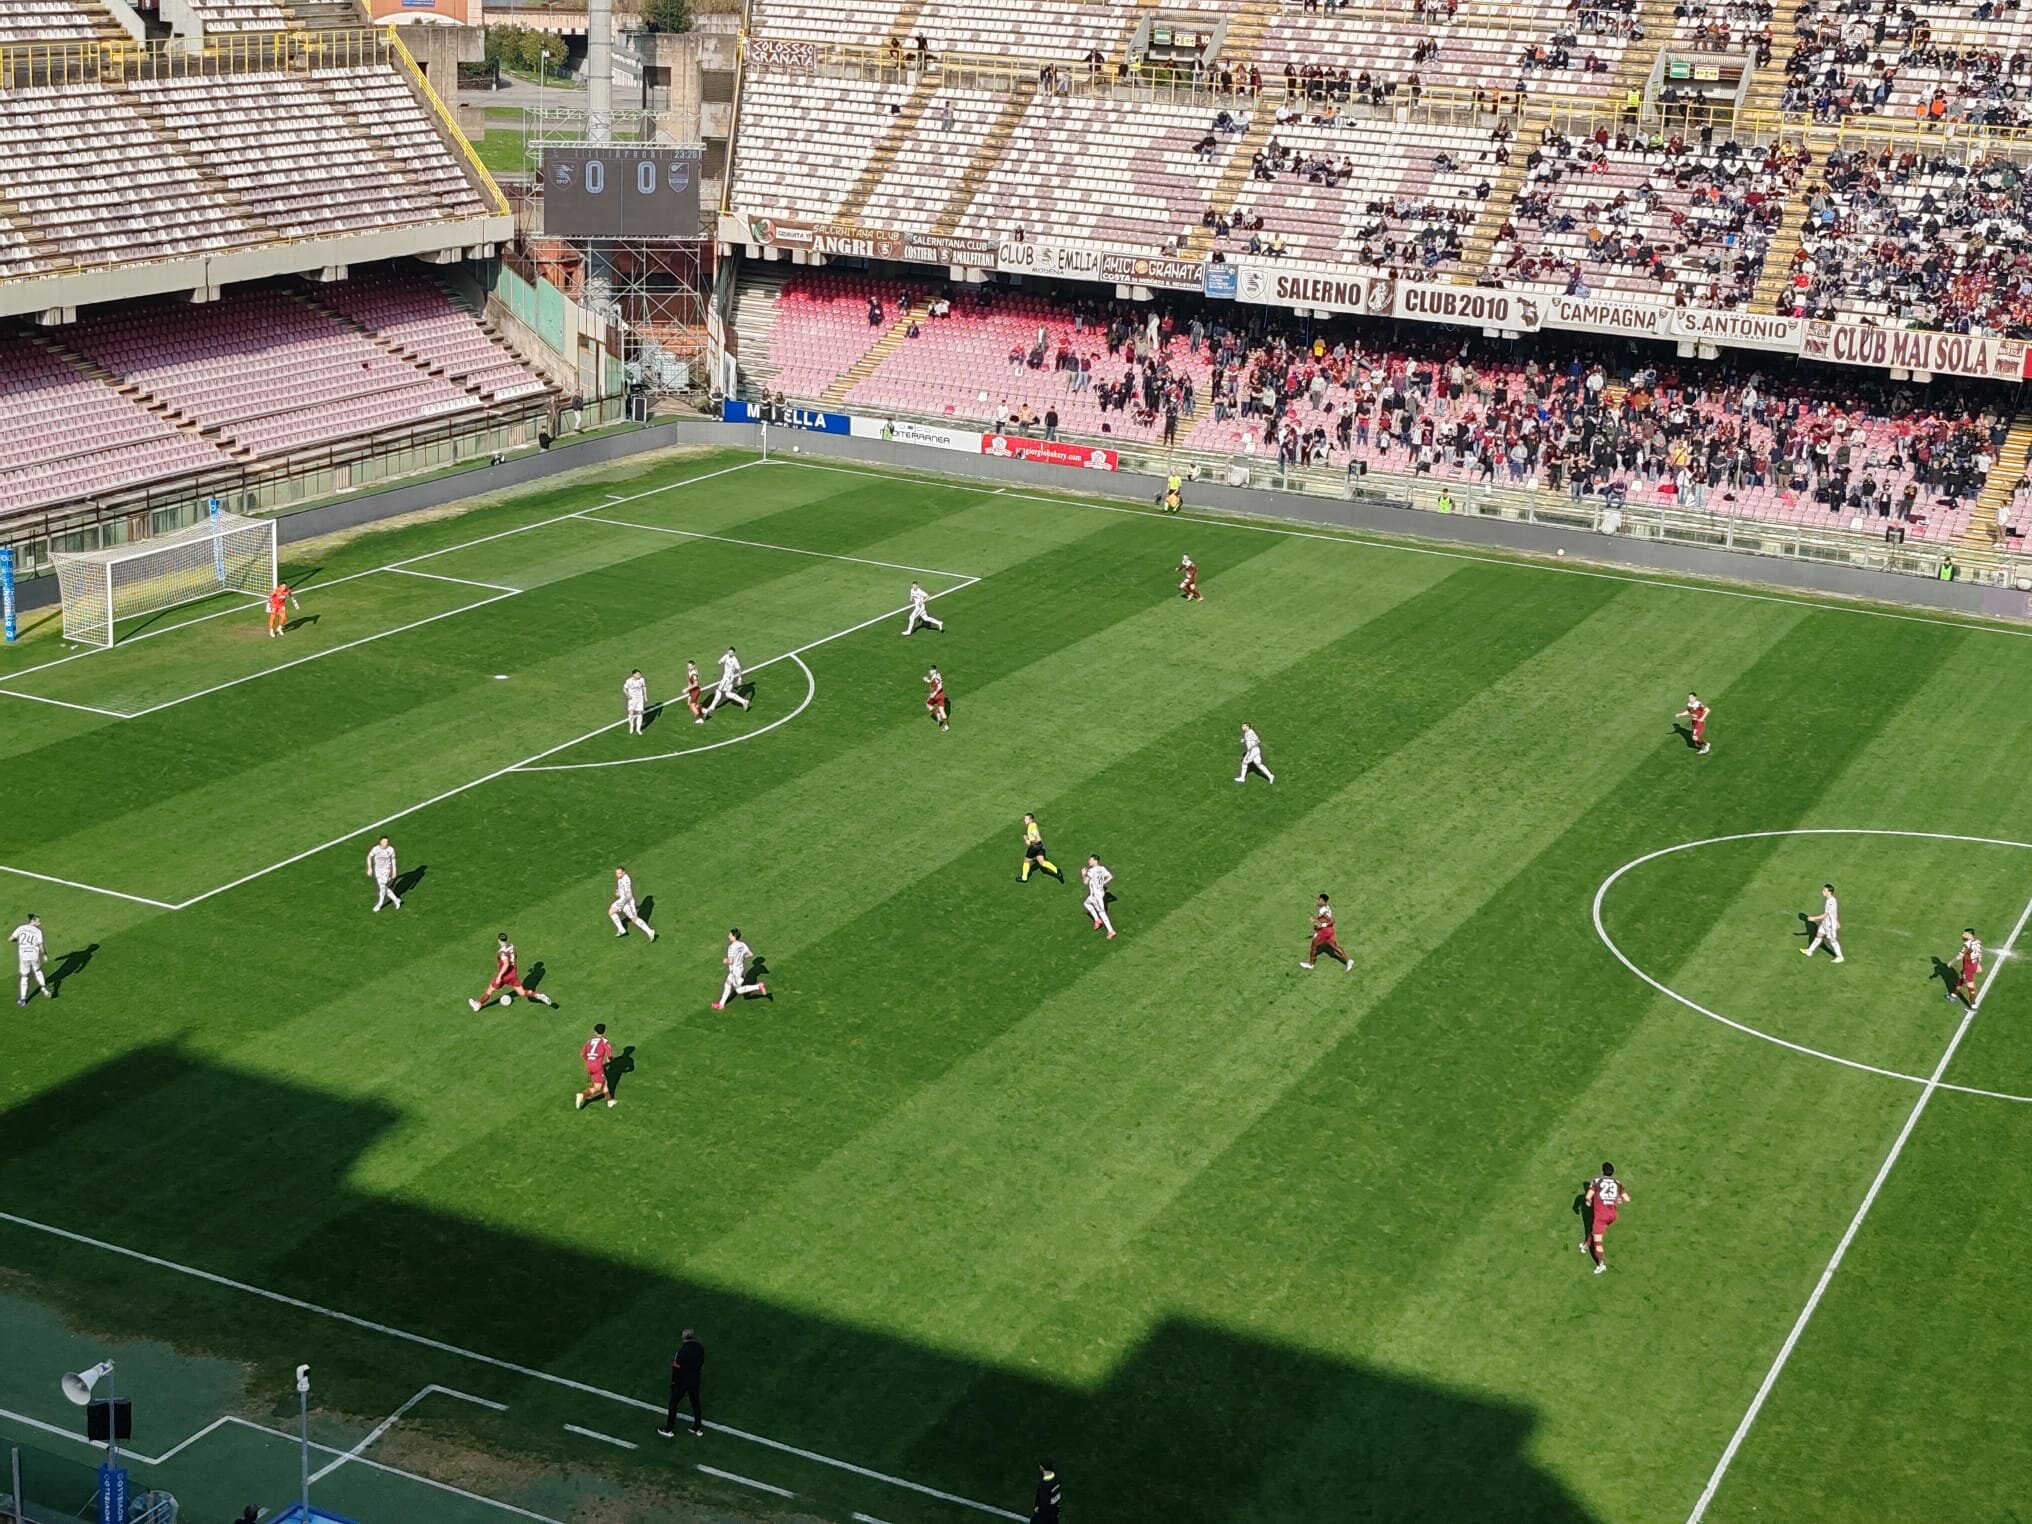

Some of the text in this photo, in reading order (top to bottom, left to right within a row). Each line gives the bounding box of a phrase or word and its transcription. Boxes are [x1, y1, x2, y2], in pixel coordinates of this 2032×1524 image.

[586, 161, 656, 193] 0 0
[812, 224, 873, 239] SALERNITANA
[876, 231, 900, 241] CLUB
[912, 236, 987, 251] SALERNITANA CLUB
[812, 235, 874, 256] ANGRI
[904, 245, 995, 266] COSTIERA AMALFITANA
[1000, 244, 1099, 272] CLUB EMILIA
[1103, 256, 1203, 280] AMICI GRANATA
[1102, 273, 1131, 282] COSTA
[1276, 276, 1361, 306] SALERNO
[1560, 302, 1657, 329] CAMPAGNA
[1685, 314, 1787, 339] S.ANTONIO
[1833, 326, 1989, 375] CLUB MAI SOLA
[21, 933, 35, 946] 24
[1600, 1181, 1618, 1197] 23
